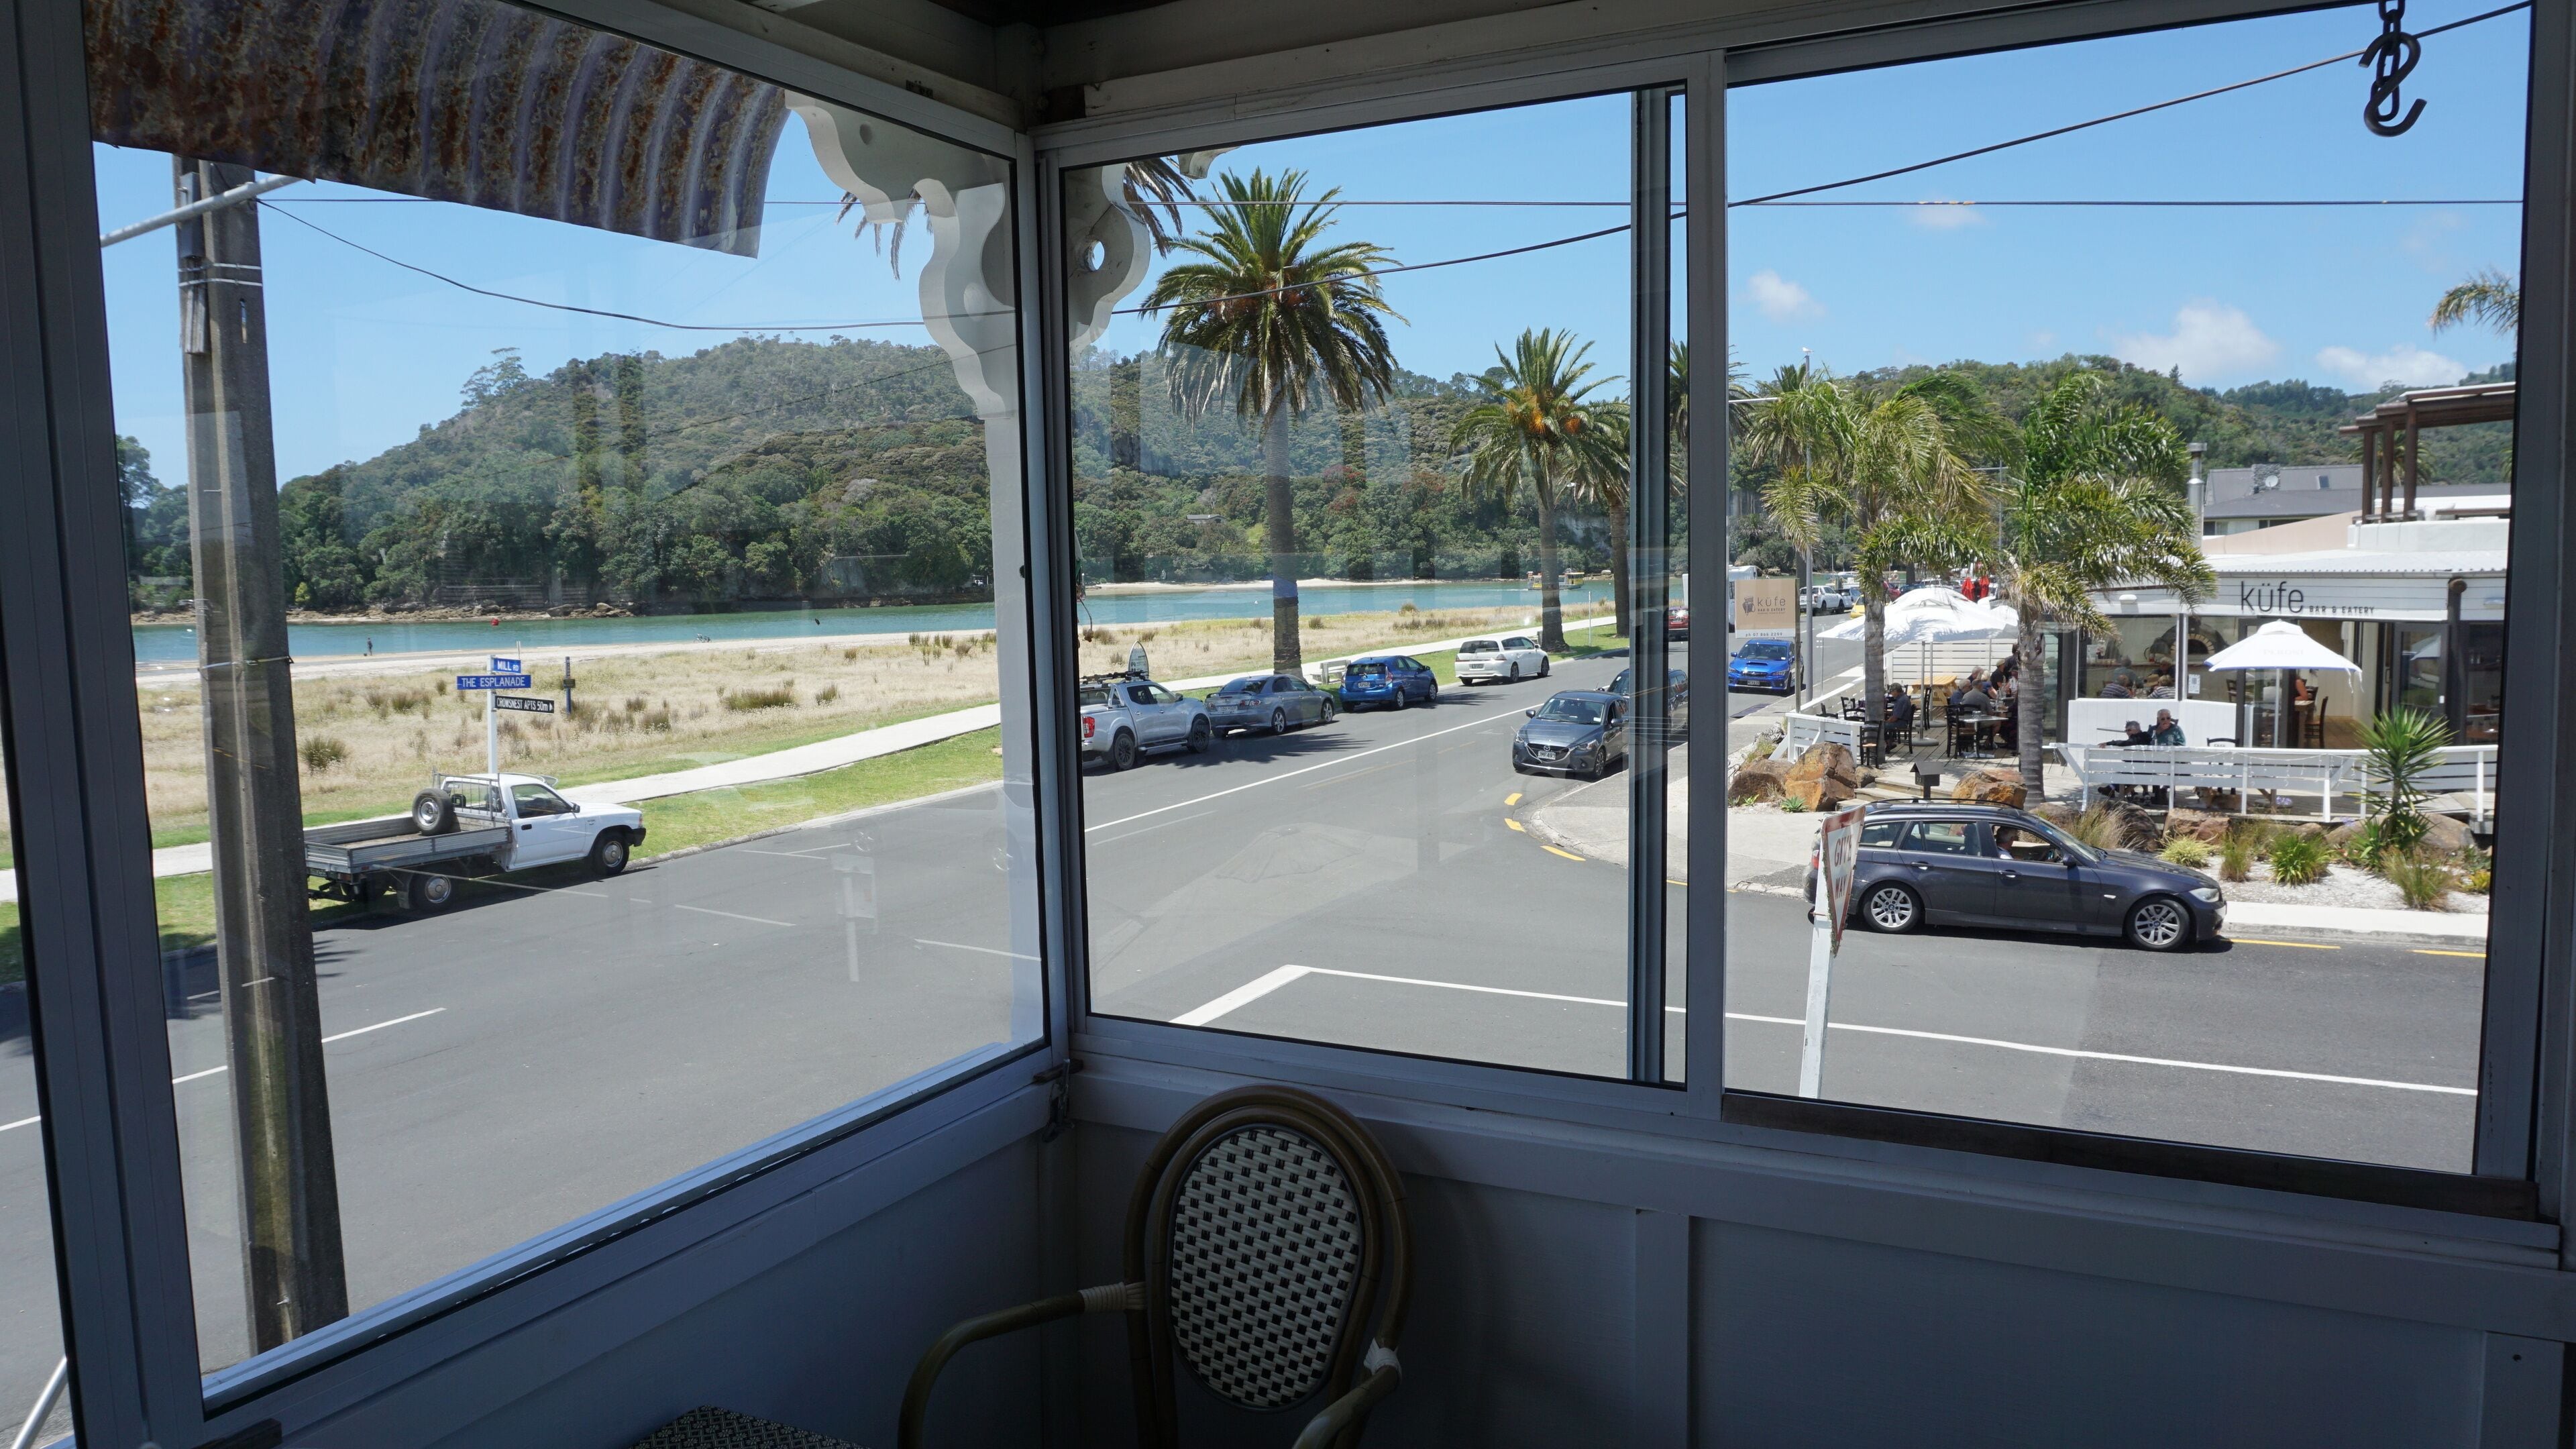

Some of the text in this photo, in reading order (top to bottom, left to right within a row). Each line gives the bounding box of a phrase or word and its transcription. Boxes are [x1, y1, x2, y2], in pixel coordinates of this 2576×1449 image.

[1758, 596, 1786, 606] küfe
[2241, 581, 2304, 613] küfe
[2342, 606, 2375, 614] EATERY
[497, 660, 512, 671] MILL
[462, 676, 525, 688] THE ESPLANADE
[496, 697, 548, 711] CROWSNEST APTS 50m
[1835, 835, 1851, 867] GIVE
[1835, 874, 1847, 900] WAY
